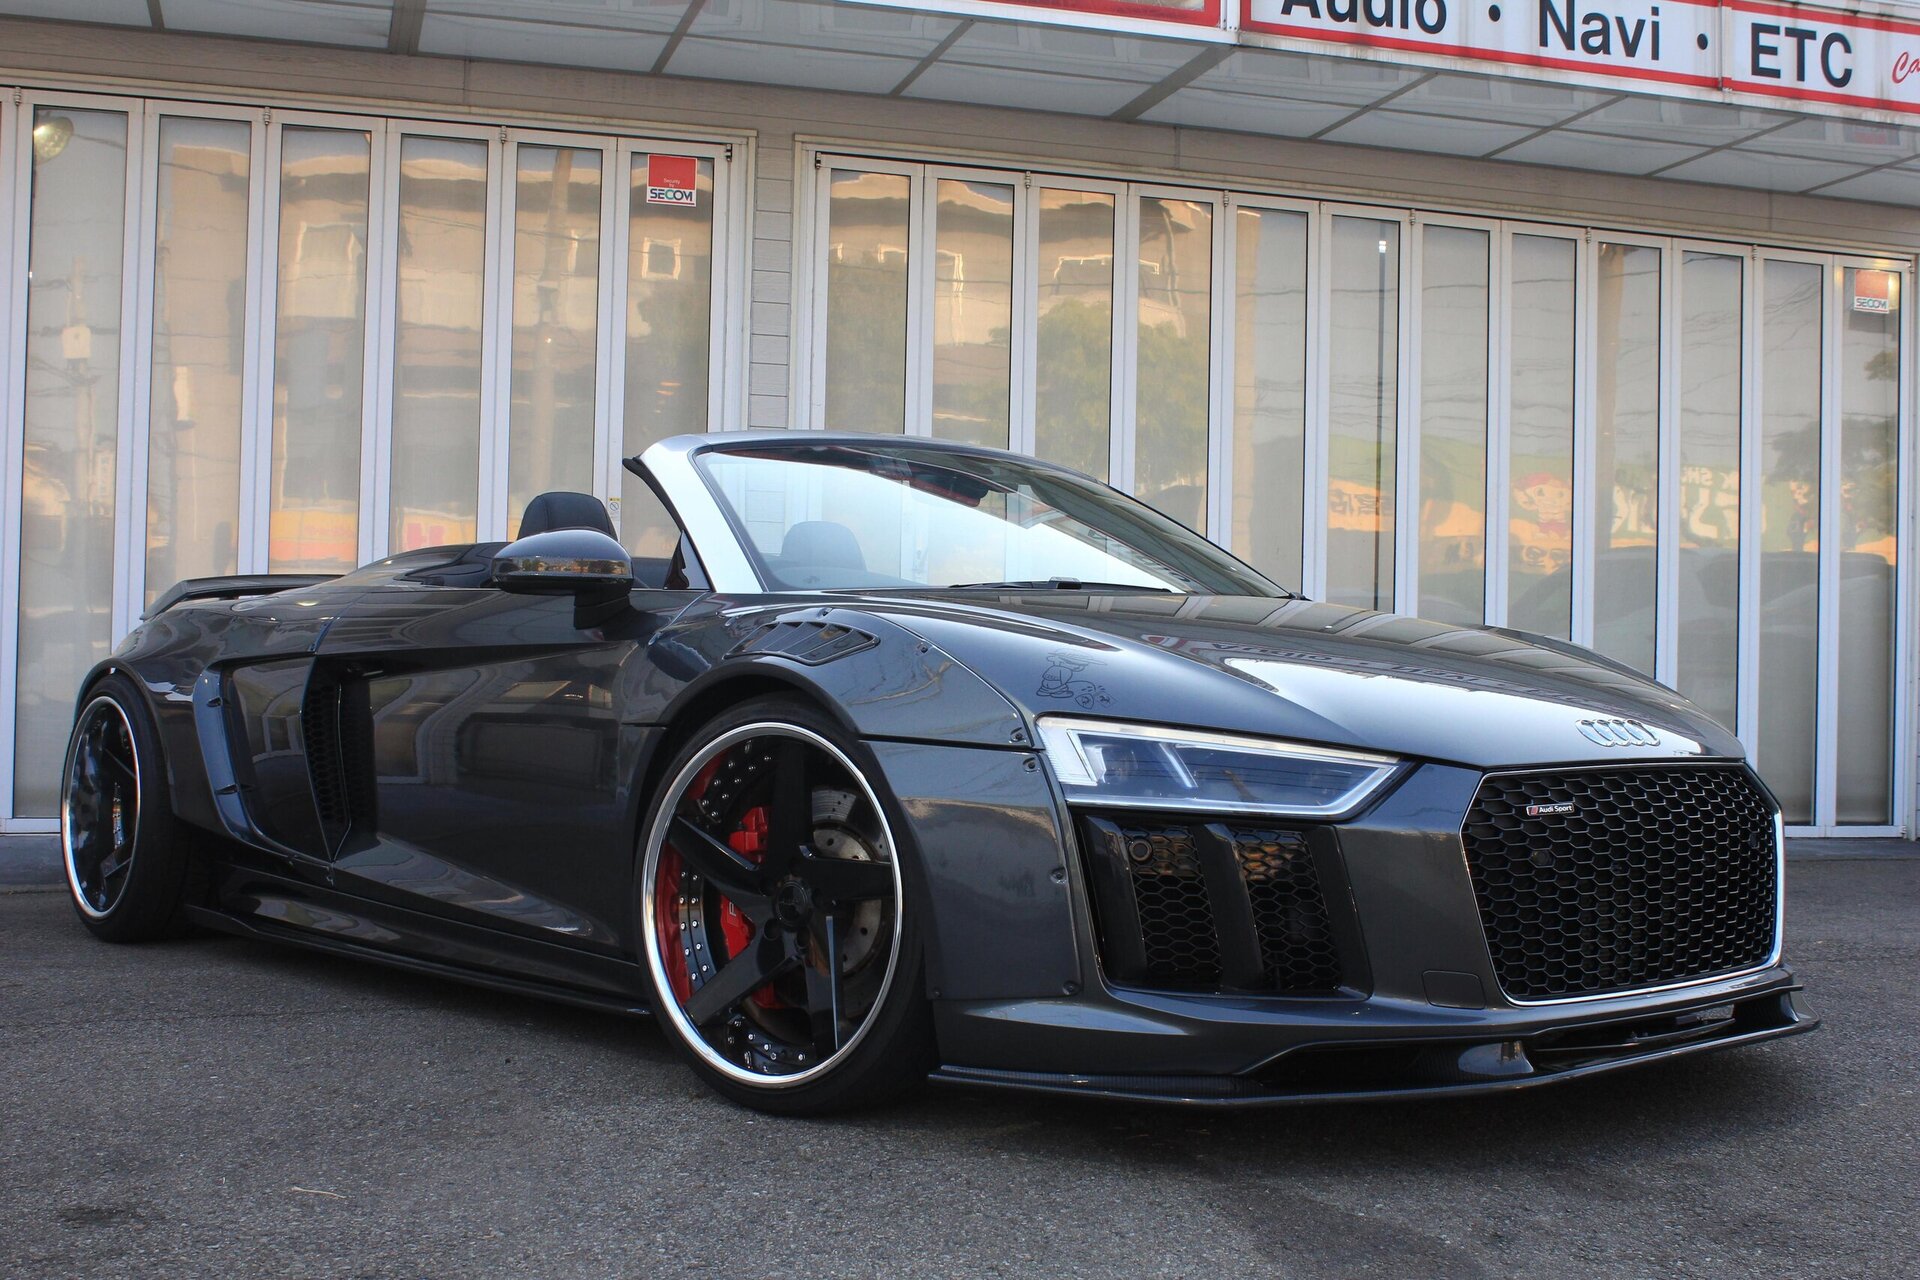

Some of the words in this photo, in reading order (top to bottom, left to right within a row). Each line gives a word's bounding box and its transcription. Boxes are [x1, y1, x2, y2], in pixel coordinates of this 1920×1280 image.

[1539, 0, 1660, 60] Navi
[1751, 22, 1853, 88] ETC
[650, 188, 693, 202] SECOM
[1855, 298, 1887, 309] SECOM
[1554, 805, 1573, 813] Sport
